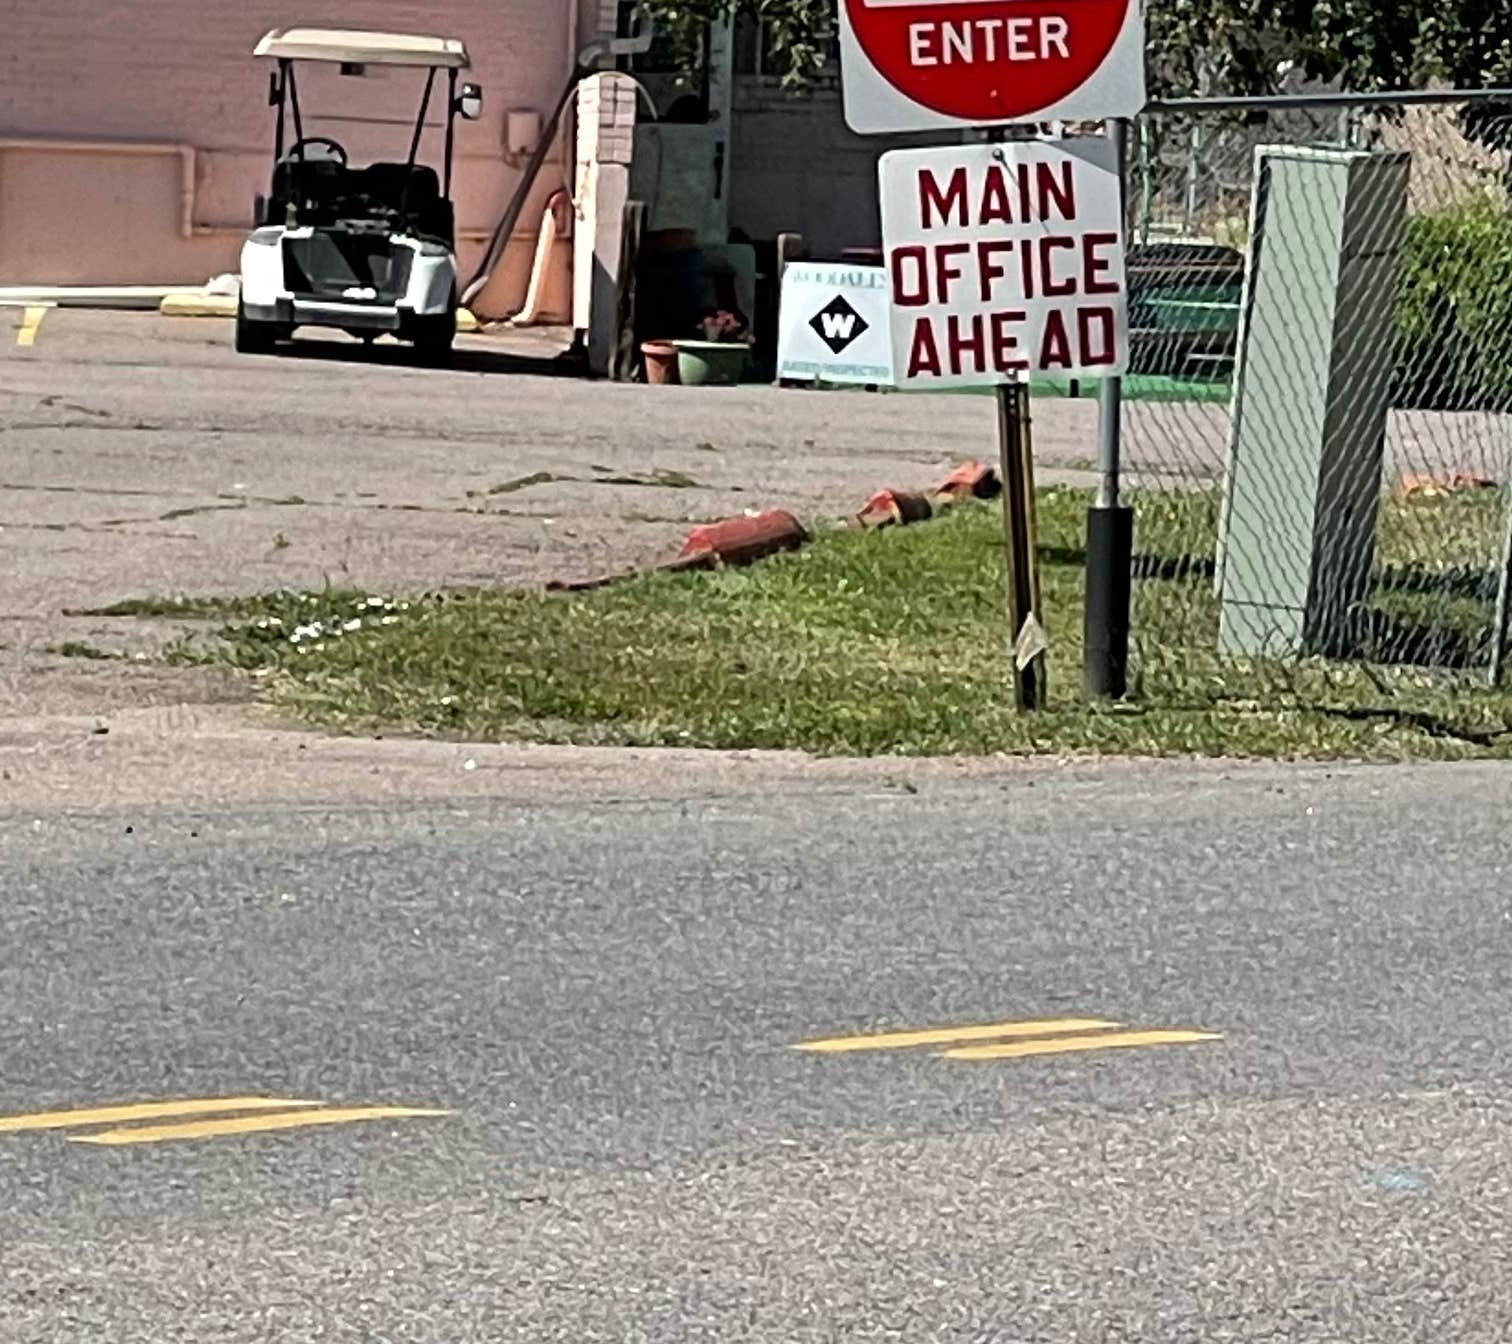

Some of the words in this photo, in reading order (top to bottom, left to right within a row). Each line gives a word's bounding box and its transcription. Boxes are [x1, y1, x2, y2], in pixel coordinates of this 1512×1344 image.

[909, 16, 1069, 67] ENTER
[918, 161, 1076, 229] MAIN
[891, 233, 1120, 307] OFFICE
[821, 313, 856, 339] W
[907, 306, 1116, 379] AHEAD
